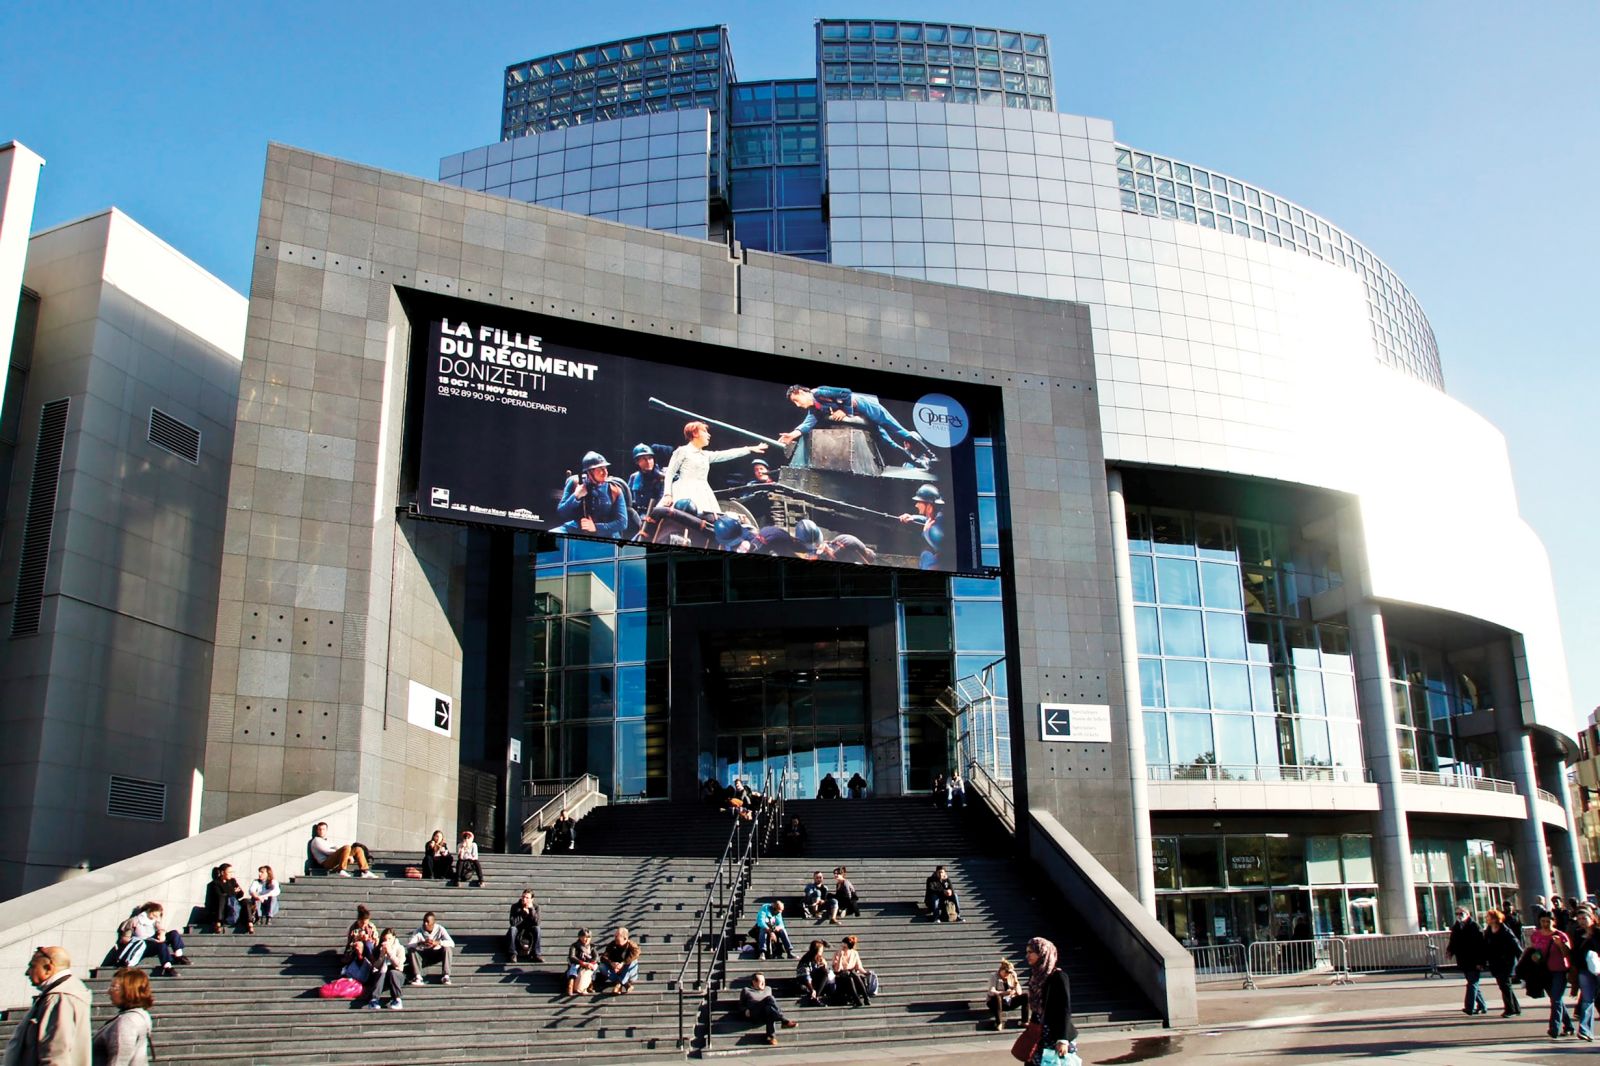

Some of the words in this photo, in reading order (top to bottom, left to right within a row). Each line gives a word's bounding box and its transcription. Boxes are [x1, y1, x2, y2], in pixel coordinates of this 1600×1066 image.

[441, 317, 473, 339] LA
[480, 325, 542, 352] FILLE
[439, 356, 546, 391] DONIZETTI
[440, 337, 474, 358] DU
[480, 346, 599, 381] RÉGIMENT
[438, 386, 449, 394] 08
[450, 388, 460, 396] 92
[461, 390, 472, 398] 89
[473, 392, 483, 400] 90
[484, 394, 495, 402] 90
[501, 397, 567, 414] OPERADEPARIS.FR
[450, 378, 470, 387] OCT
[486, 385, 505, 394] NOV
[507, 388, 528, 398] 2012
